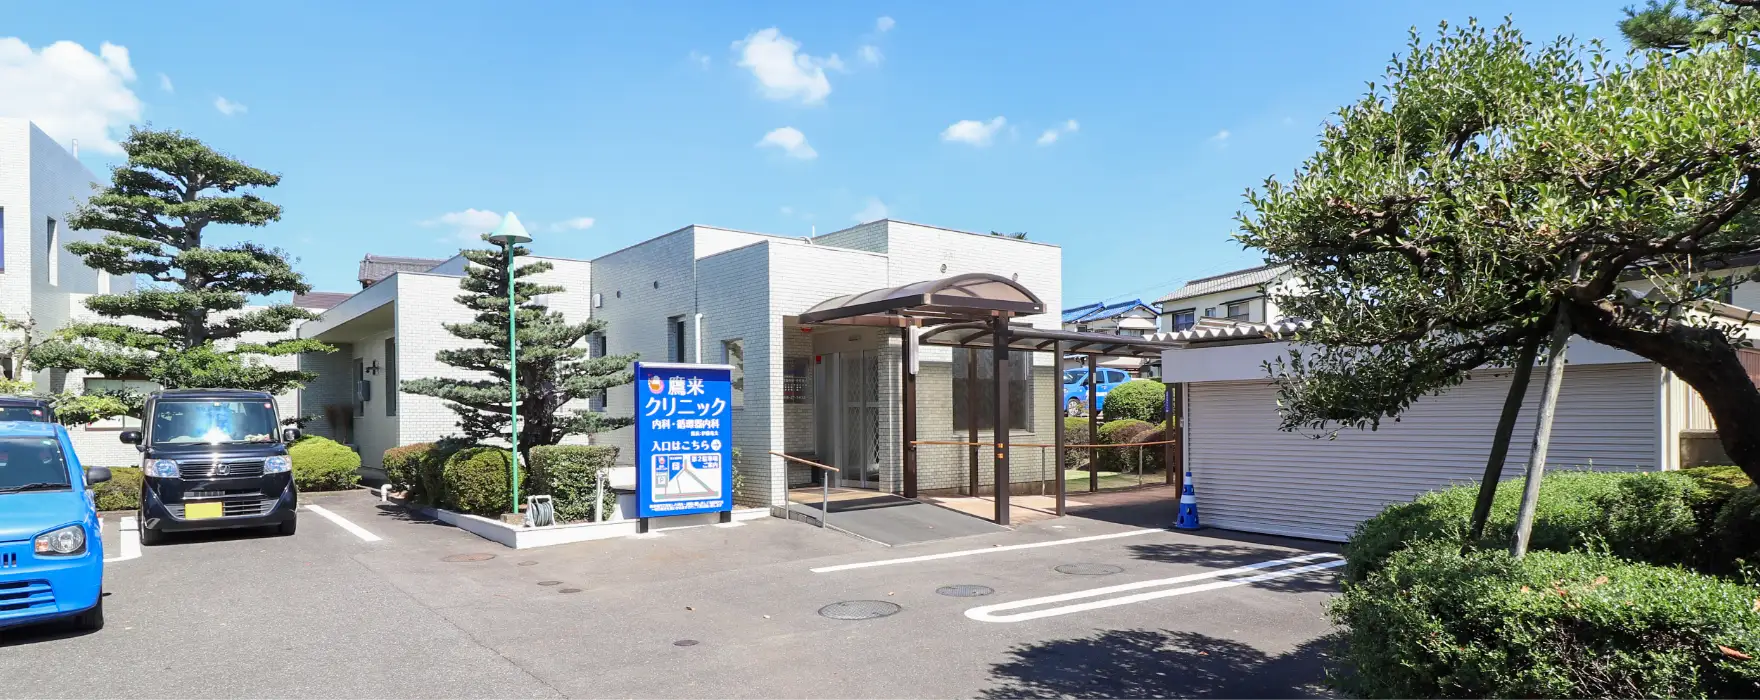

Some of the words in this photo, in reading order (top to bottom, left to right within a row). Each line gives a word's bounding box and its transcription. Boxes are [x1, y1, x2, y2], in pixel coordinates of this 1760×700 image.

[668, 376, 705, 396] 鷹来
[645, 397, 727, 417] クリニック
[651, 440, 710, 452] 入口はこちら
